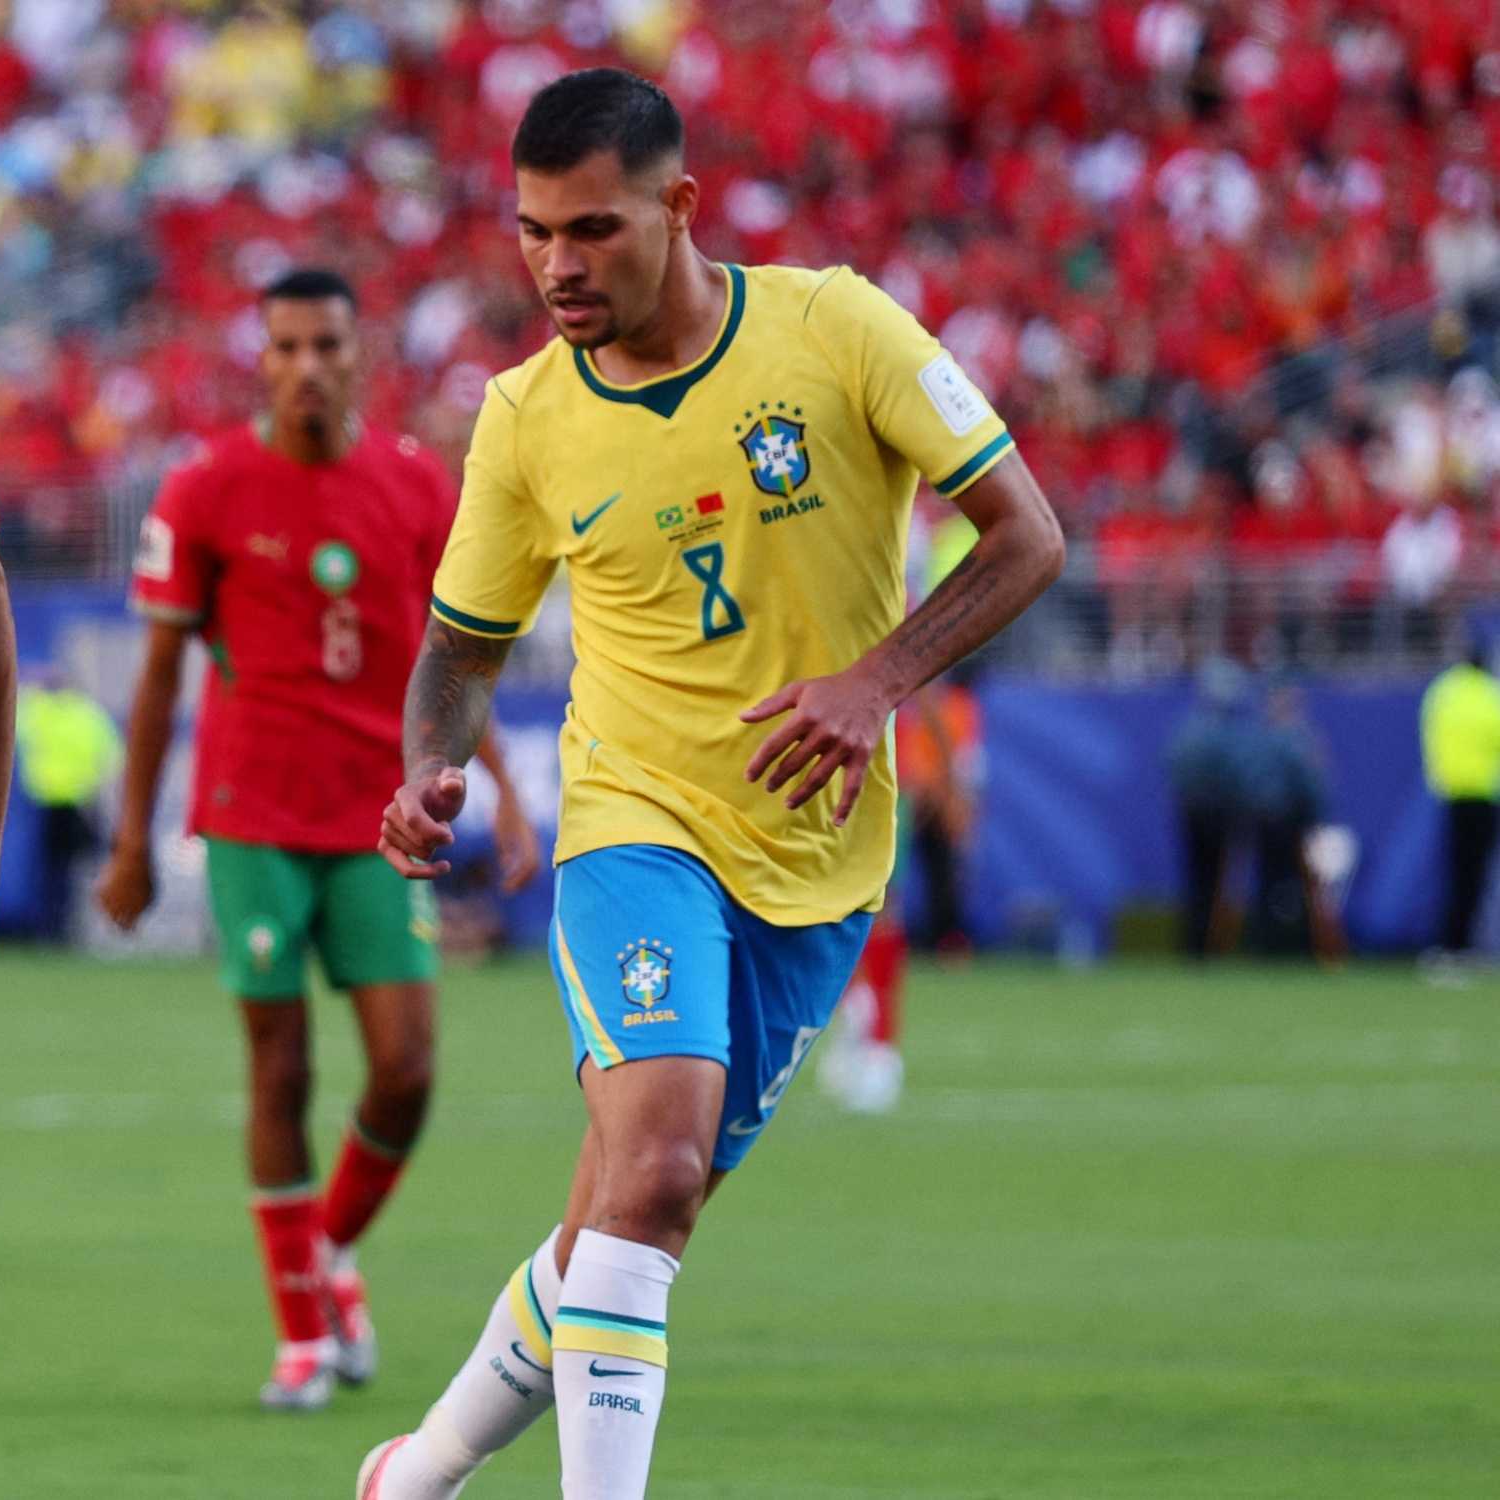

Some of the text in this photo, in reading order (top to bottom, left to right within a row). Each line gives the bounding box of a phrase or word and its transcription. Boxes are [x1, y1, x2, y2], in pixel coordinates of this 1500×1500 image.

[759, 495, 826, 524] BRASIL
[682, 541, 747, 641] 8
[623, 1010, 679, 1027] BRASIL
[589, 1392, 644, 1415] BRASIL
